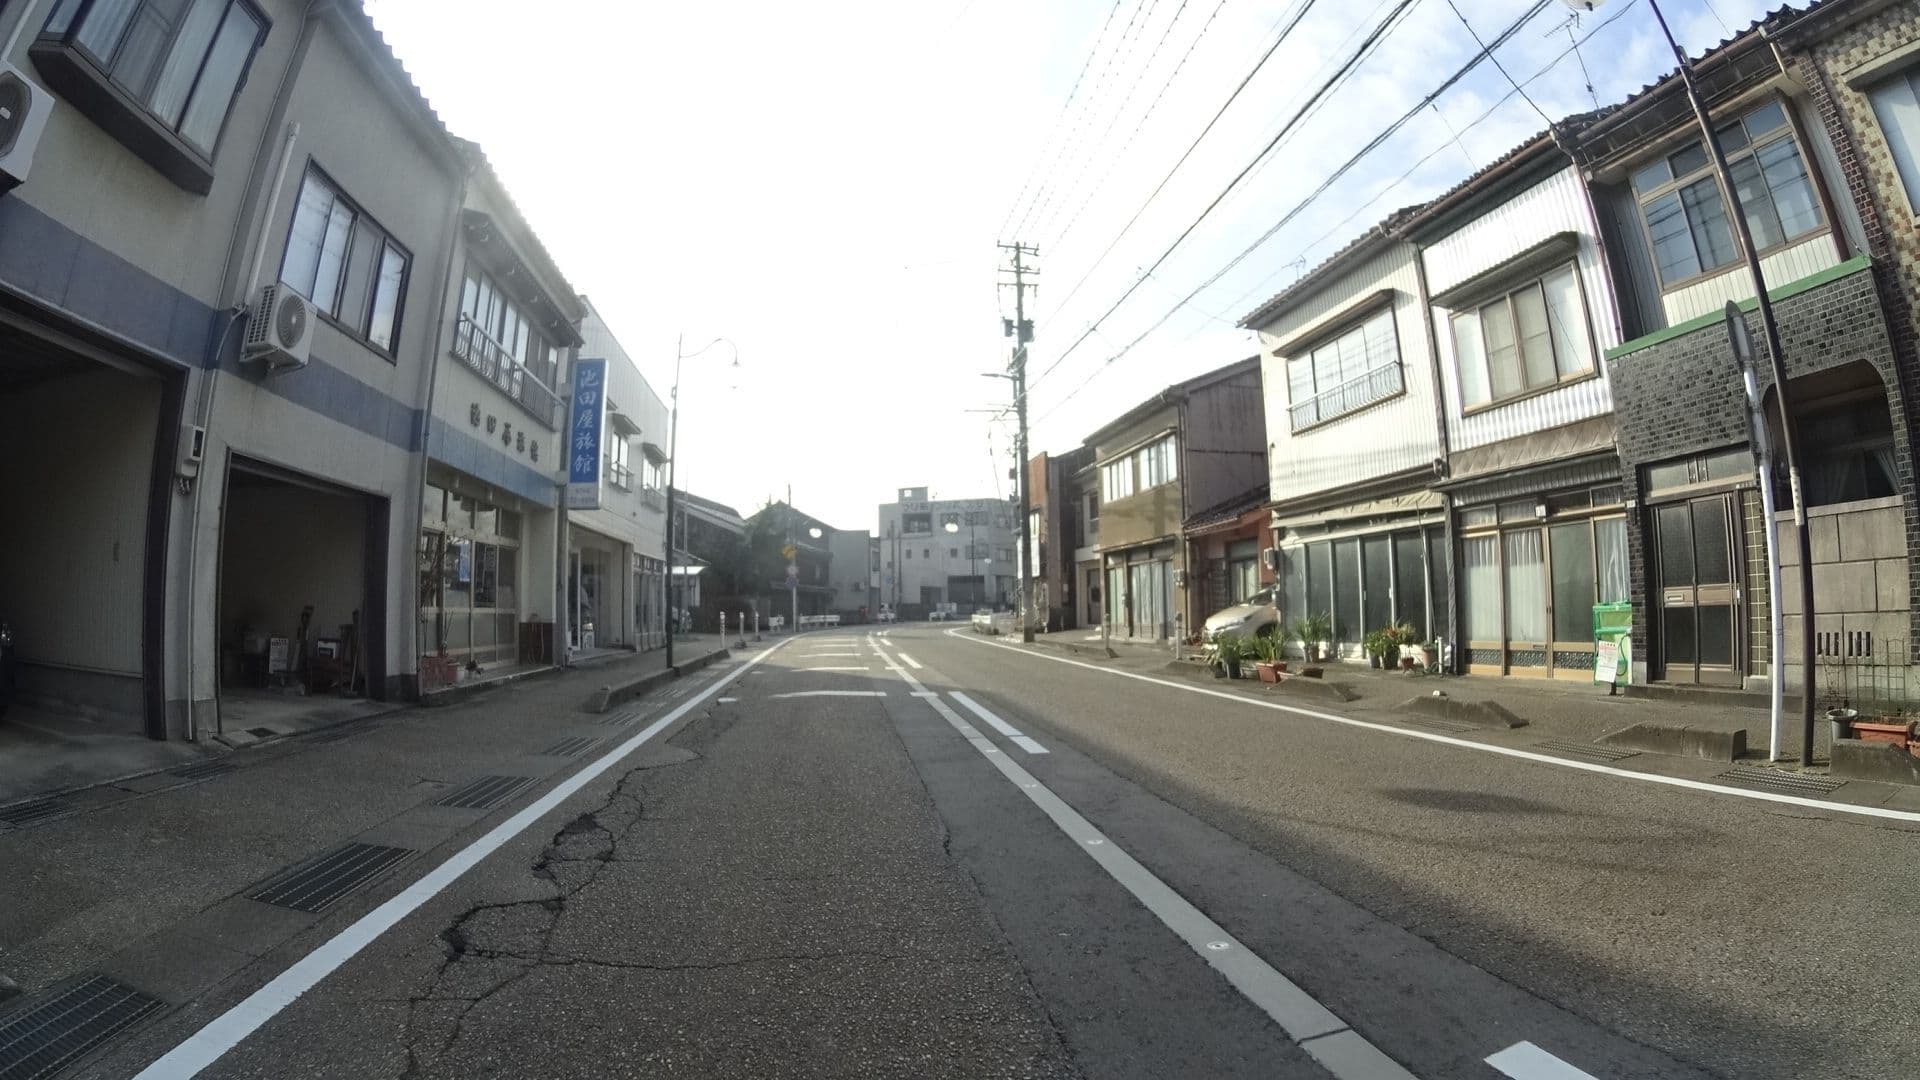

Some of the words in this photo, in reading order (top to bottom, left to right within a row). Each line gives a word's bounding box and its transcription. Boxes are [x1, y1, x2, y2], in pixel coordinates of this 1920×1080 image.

[575, 370, 599, 474] 池田屋旅館
